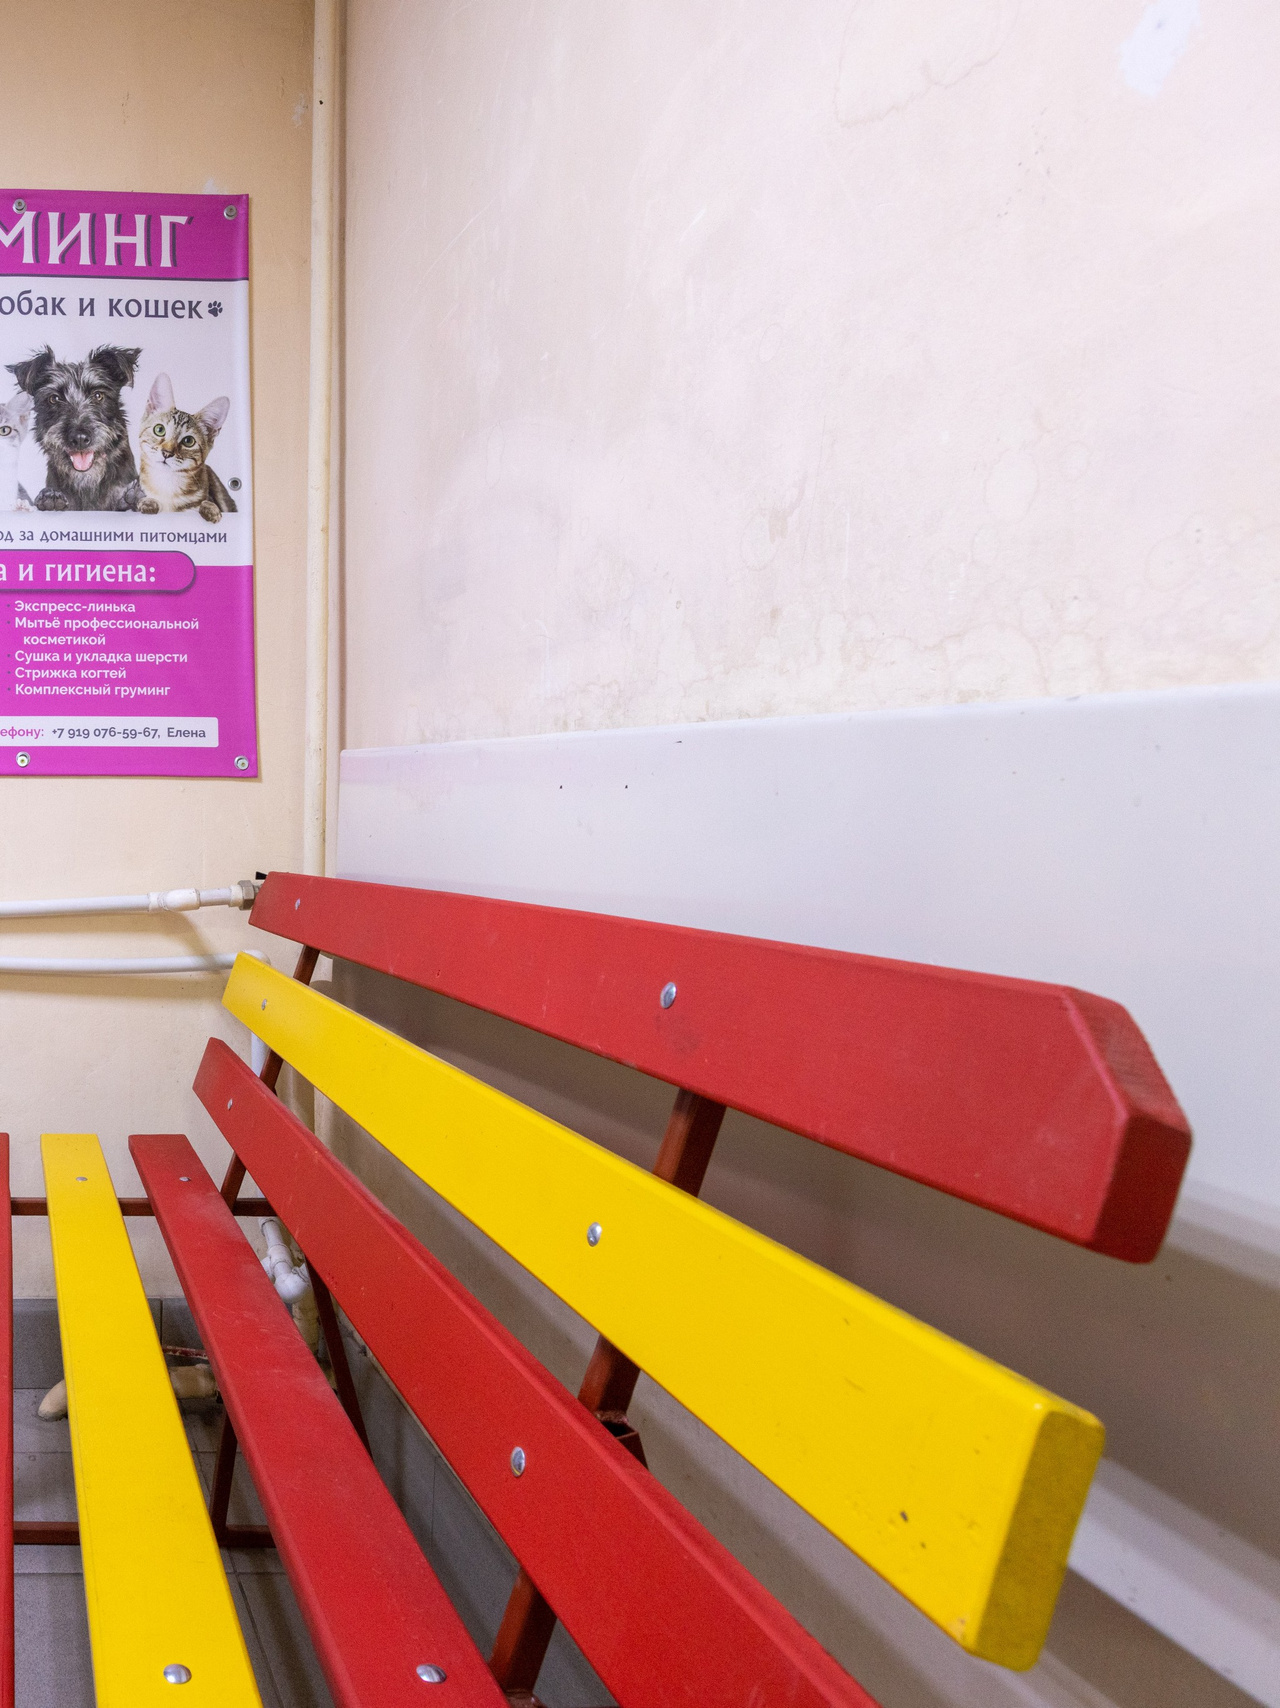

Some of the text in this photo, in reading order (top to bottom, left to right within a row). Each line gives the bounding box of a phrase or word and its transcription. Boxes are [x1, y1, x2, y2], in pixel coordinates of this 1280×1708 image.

[78, 297, 96, 317] и
[108, 297, 204, 320] кошек
[19, 530, 35, 543] за
[39, 530, 134, 544] домашними
[139, 531, 228, 546] питомцами
[18, 563, 34, 583] и
[45, 563, 157, 583] гигиена:
[14, 600, 136, 614] Экспресс-линька
[14, 616, 199, 632] Мытьё профессиональной
[23, 633, 106, 646] косметикой
[14, 650, 188, 665] Сушка и укладка шерсти
[14, 667, 127, 681] Стрижка когтей
[15, 683, 171, 698] Комплексный груминг
[51, 728, 65, 739] +7
[67, 728, 91, 740] 919
[93, 727, 161, 740] 076-59-67,
[166, 726, 207, 739] Елена
